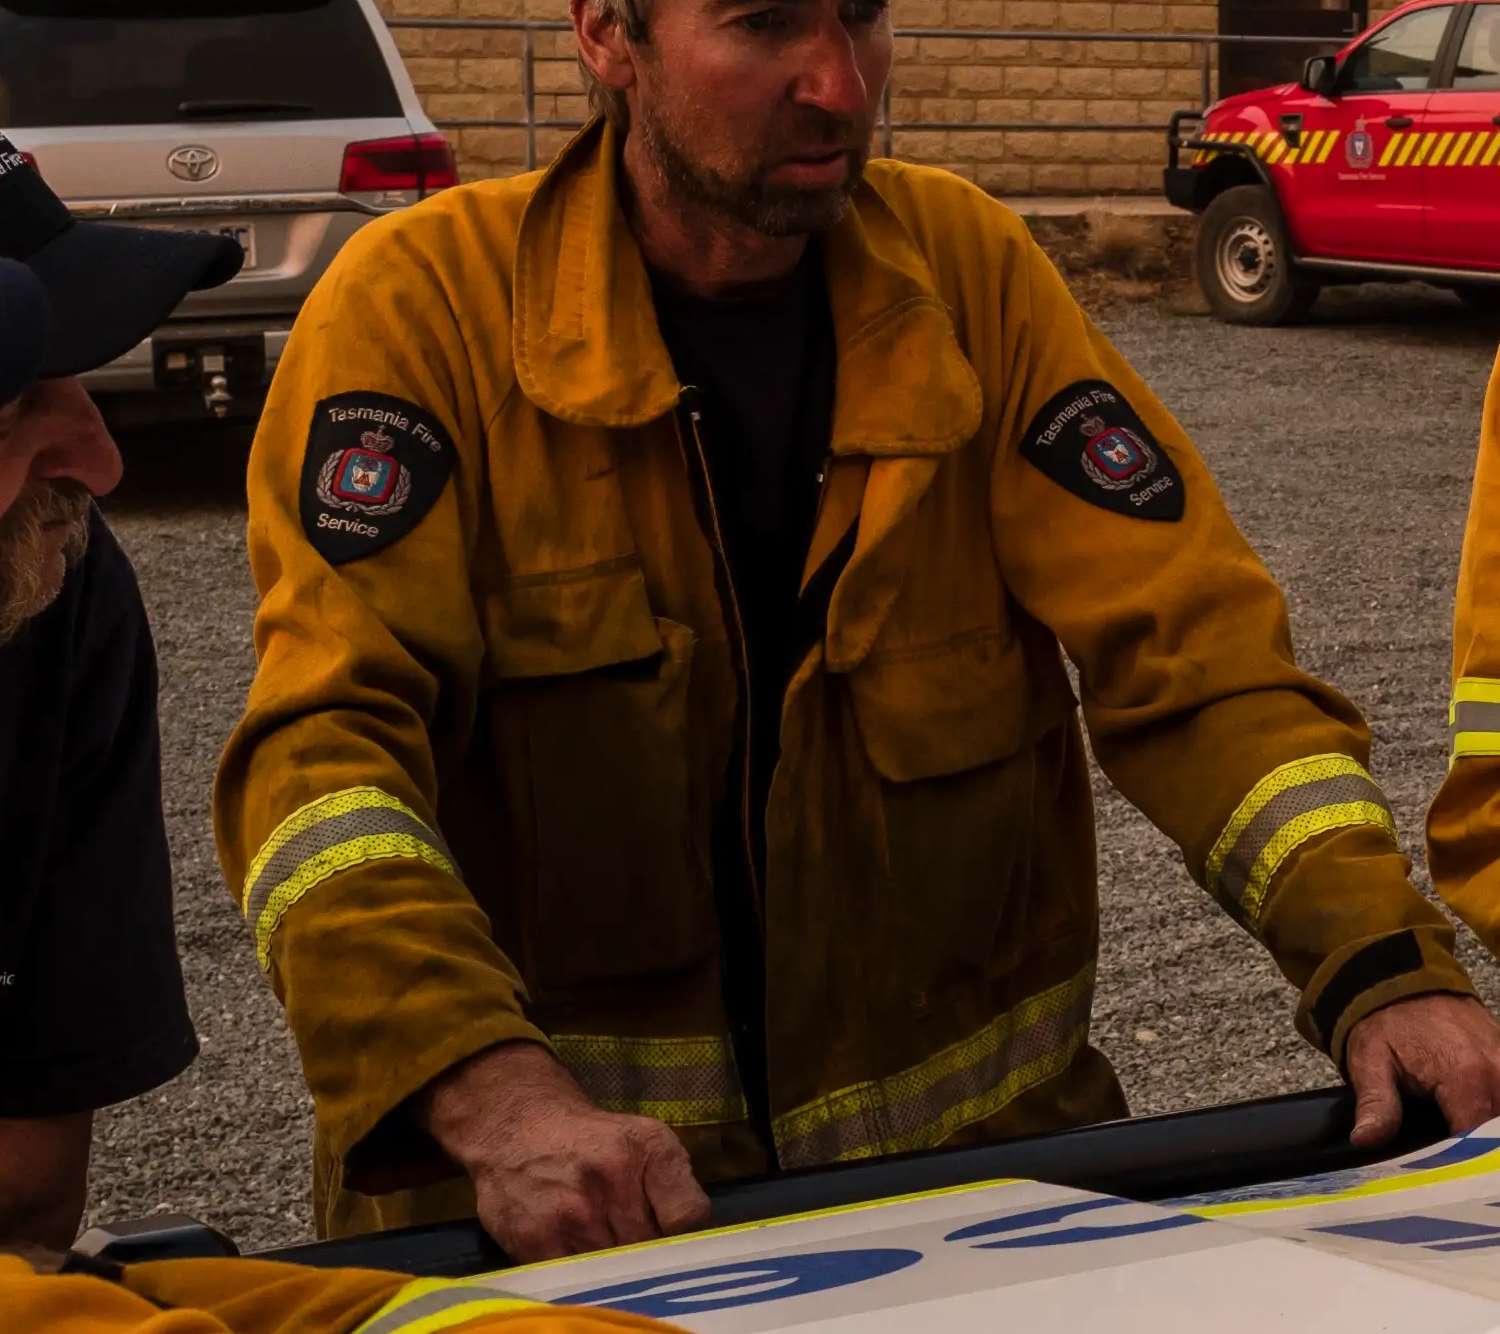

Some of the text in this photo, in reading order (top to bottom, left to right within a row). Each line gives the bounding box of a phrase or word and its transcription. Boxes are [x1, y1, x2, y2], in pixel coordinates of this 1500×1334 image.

[328, 406, 442, 453] Tasmania Fire
[1036, 389, 1117, 447] Tasmania Fire
[1129, 474, 1174, 507] Service
[316, 513, 380, 538] Service
